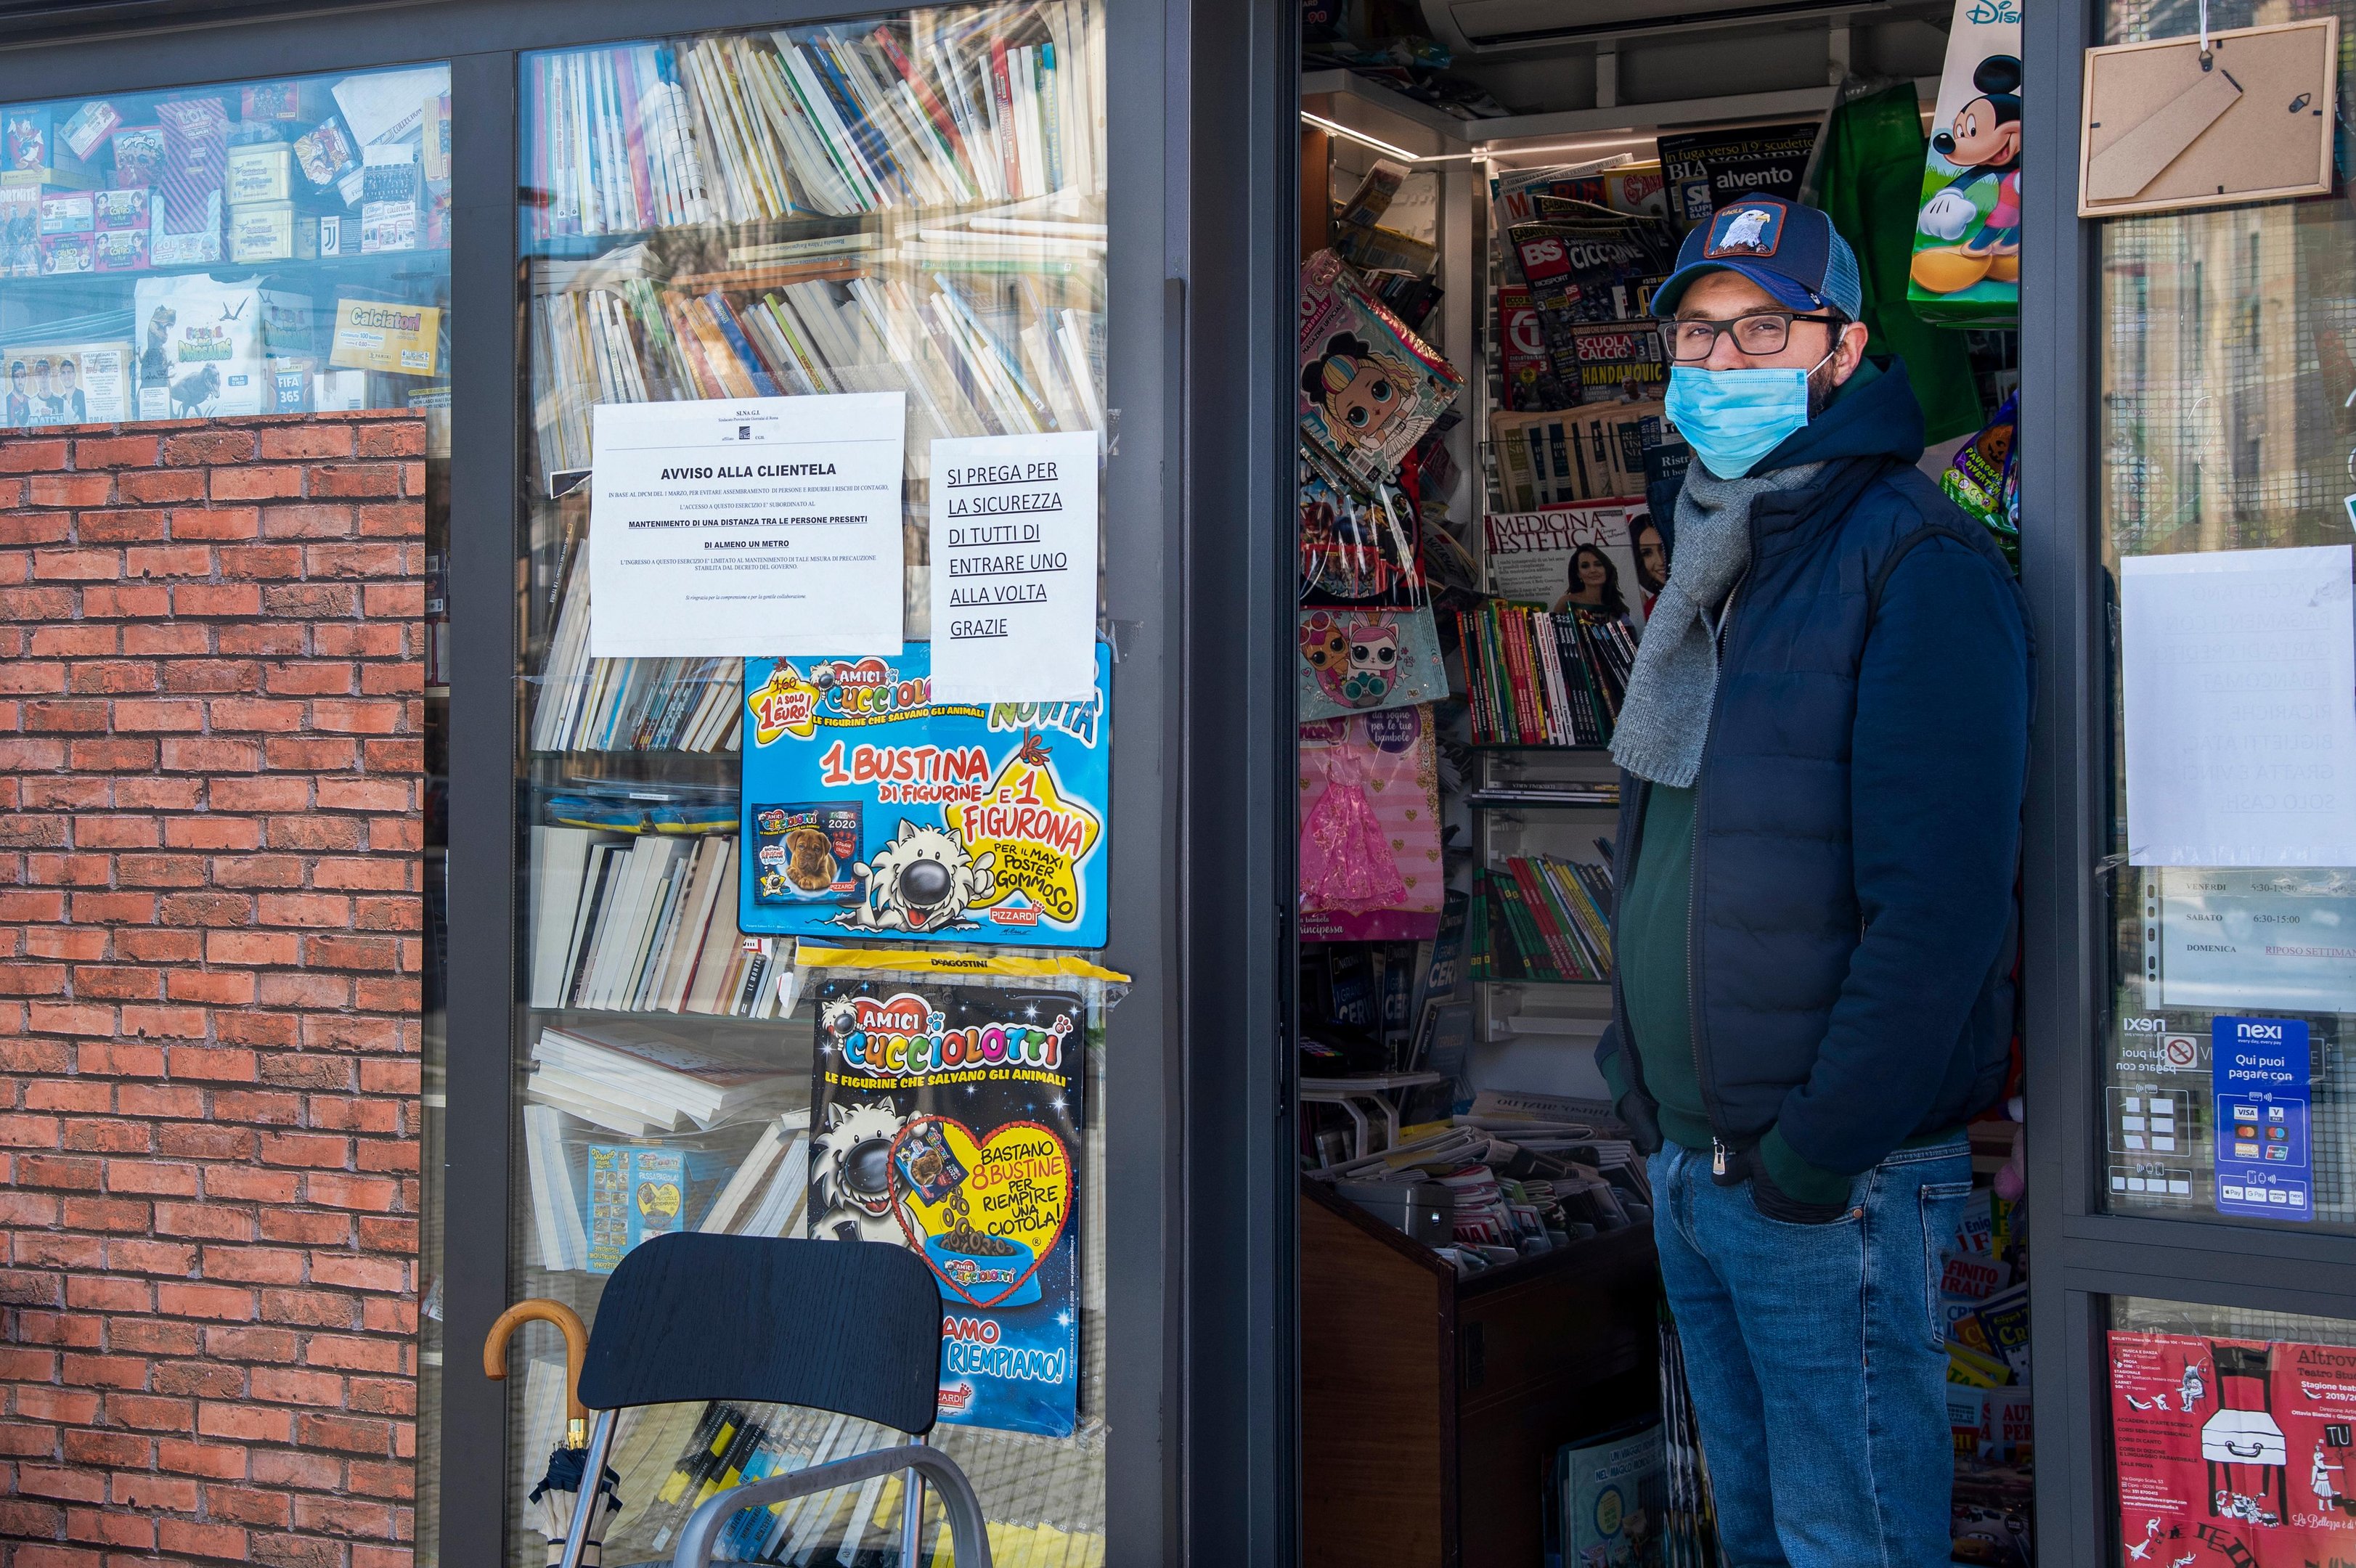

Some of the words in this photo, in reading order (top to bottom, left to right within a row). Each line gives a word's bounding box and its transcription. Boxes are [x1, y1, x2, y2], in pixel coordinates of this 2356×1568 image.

[1966, 0, 2021, 24] Dis
[1665, 152, 1676, 163] In
[1679, 150, 1705, 163] fuga
[1708, 144, 1739, 158] verso
[1765, 138, 1814, 151] scudetto
[1716, 167, 1793, 189] alvento
[1521, 239, 1562, 266] BS
[1570, 242, 1644, 269] CICCONE
[1534, 274, 1568, 287] BICISPORT
[351, 307, 421, 331] Calciatori
[1302, 327, 1325, 354] MAGAZINE
[1576, 335, 1633, 350] SCUOLA
[1578, 348, 1629, 361] CALCIO
[1639, 346, 1646, 356] 3
[278, 376, 299, 388] FIFA
[1582, 363, 1663, 385] HANDANOVIC
[280, 391, 299, 402] 365
[661, 467, 712, 479] AVVISO
[717, 466, 753, 478] ALLA
[758, 464, 836, 476] CLIENTELA
[948, 469, 961, 484] SI
[968, 465, 1022, 483] PREGA
[1028, 463, 1057, 479] PER
[1965, 460, 2001, 494] DIVERTEN
[950, 499, 968, 514] LA
[974, 493, 1062, 513] SICUREZZA
[1495, 510, 1607, 536] MEDICINA
[950, 528, 964, 544] DI
[970, 526, 1016, 543] TUTTI
[1024, 524, 1038, 539] DI
[1498, 528, 1610, 555] ESTETICA
[950, 555, 1024, 573] ENTRARE
[1031, 552, 1067, 569] UNO
[950, 587, 989, 604] ALLA
[995, 584, 1046, 601] VOLTA
[951, 619, 1007, 636] GRAZIE
[840, 671, 880, 684] AMICI
[777, 697, 783, 706] A
[785, 693, 804, 703] SOLO
[828, 679, 931, 712] CUCCIOL
[760, 698, 775, 730] 1
[774, 695, 812, 721] EURO!
[812, 716, 822, 724] LE
[824, 717, 866, 727] FIGURINE
[868, 715, 886, 725] CHE
[888, 709, 929, 722] SALVANO
[931, 707, 945, 716] GLI
[947, 706, 985, 719] ANIMALI
[1386, 712, 1411, 724] sogno
[1371, 722, 1385, 731] per
[1387, 720, 1397, 730] le
[1374, 732, 1410, 743] bambole
[823, 744, 849, 784] 1
[854, 748, 989, 783] BUSTINA
[880, 785, 897, 801] DI
[902, 784, 982, 804] FIGURINE
[1000, 789, 1011, 804] E
[1016, 771, 1040, 805] 1
[828, 820, 856, 829] 2020
[963, 806, 1083, 856] FIGURONA
[995, 843, 1016, 855] PER
[1021, 848, 1028, 857] IL
[1030, 848, 1063, 870] MAXI
[1005, 854, 1055, 880] POSTER
[996, 870, 1074, 915] GOMMOSO
[992, 910, 1036, 921] PIZZARDI
[2253, 915, 2300, 924] 6:30-15:00
[1300, 924, 1344, 936] rincipessa
[2187, 944, 2236, 952] DOMENICA
[2265, 946, 2303, 955] RIPOSO
[2305, 947, 2356, 957] SETTIMAN
[864, 1011, 918, 1029] AMICI
[2238, 1024, 2282, 1040] nexi
[846, 1027, 1058, 1071] CUCCIOLOTTI
[2235, 1054, 2257, 1066] Qui
[2259, 1055, 2285, 1068] puoi
[825, 1071, 838, 1084] LE
[841, 1074, 897, 1089] FIGURINE
[900, 1076, 925, 1088] CHE
[928, 1070, 986, 1086] SALVANO
[989, 1069, 1009, 1080] GLI
[1011, 1069, 1067, 1087] ANIMALI
[2229, 1069, 2268, 1081] pagare
[2270, 1071, 2292, 1080] con
[981, 1140, 1053, 1166] BASTANO
[971, 1164, 989, 1190] 8
[990, 1156, 1063, 1185] BUSTINE
[1008, 1178, 1036, 1193] PER
[983, 1185, 1059, 1212] RIEMPIRE
[987, 1202, 1061, 1236] CIOTOLA!
[1012, 1204, 1039, 1219] UNA
[952, 1267, 1014, 1283] CUCCIOLOTTI
[942, 1317, 999, 1343] AMO
[950, 1343, 1064, 1383] RIEMPIAMO!
[2297, 1368, 2332, 1378] Teatro
[2301, 1381, 2337, 1391] Stagione
[2326, 1426, 2350, 1446] TU
[2308, 1514, 2340, 1531] Bellezza
